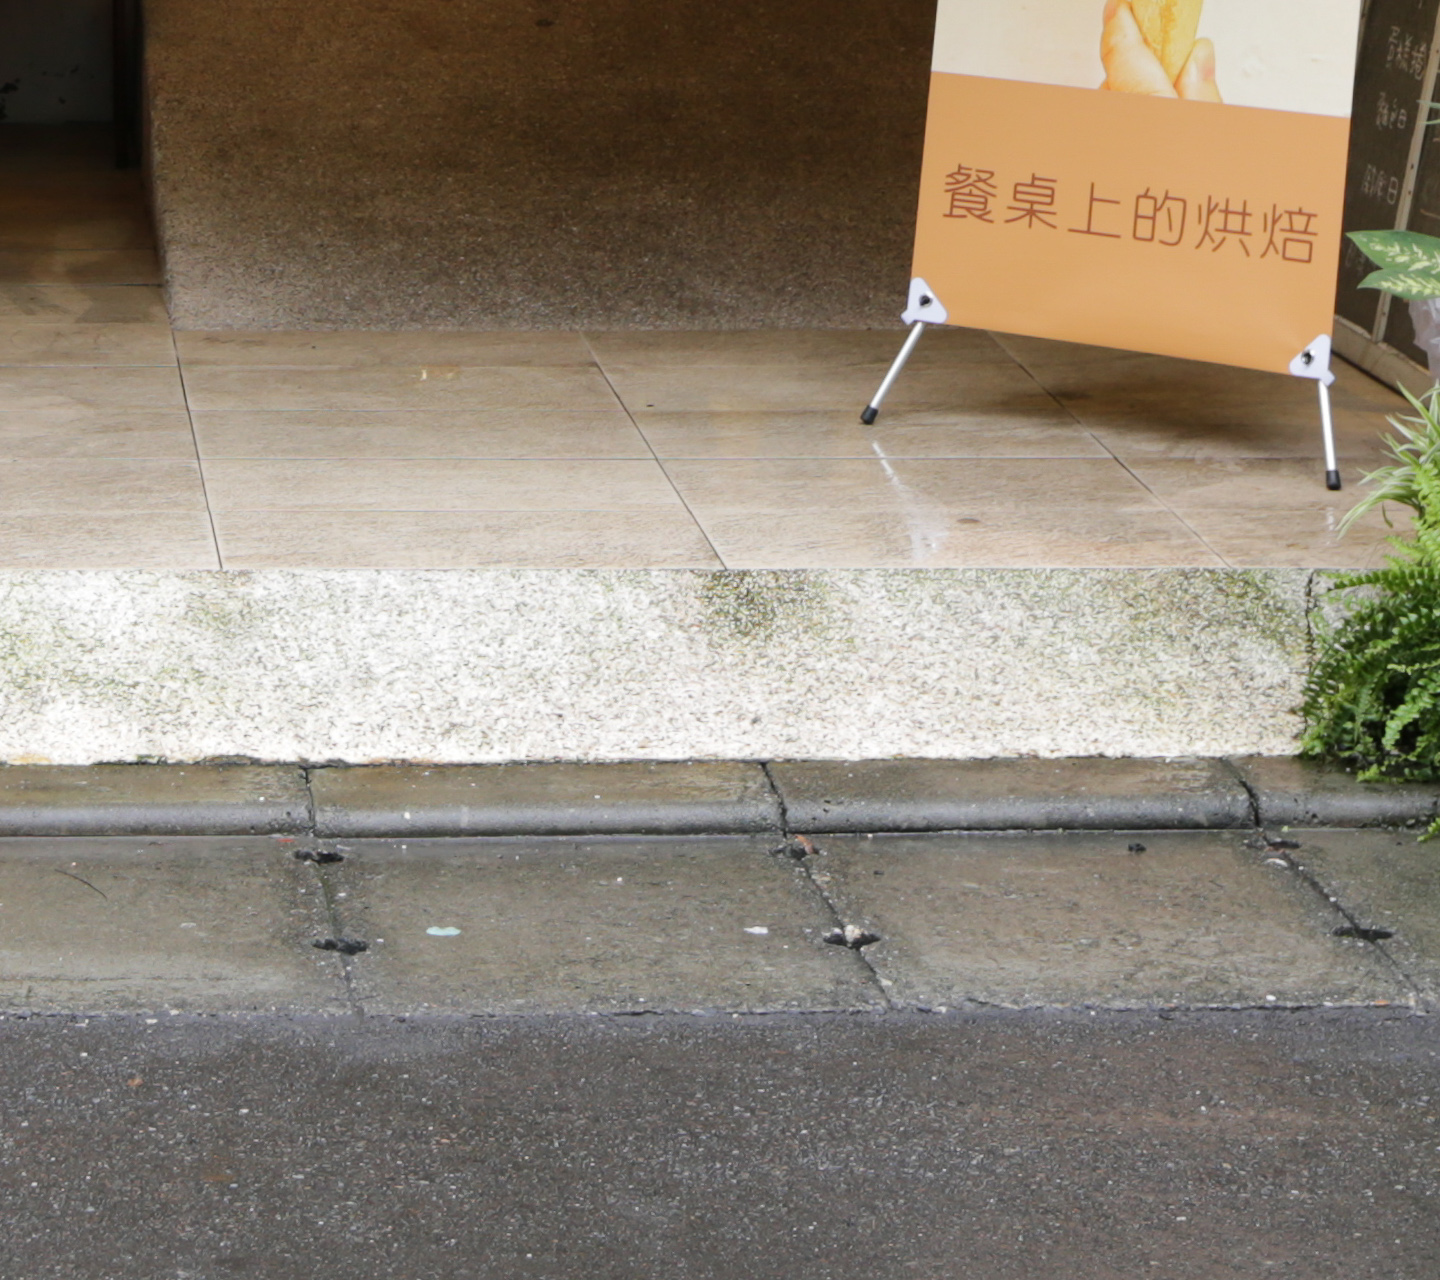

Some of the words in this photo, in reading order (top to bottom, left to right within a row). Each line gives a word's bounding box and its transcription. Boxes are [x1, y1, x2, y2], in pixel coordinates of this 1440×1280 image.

[940, 162, 1320, 265] 餐桌上的烘焙
